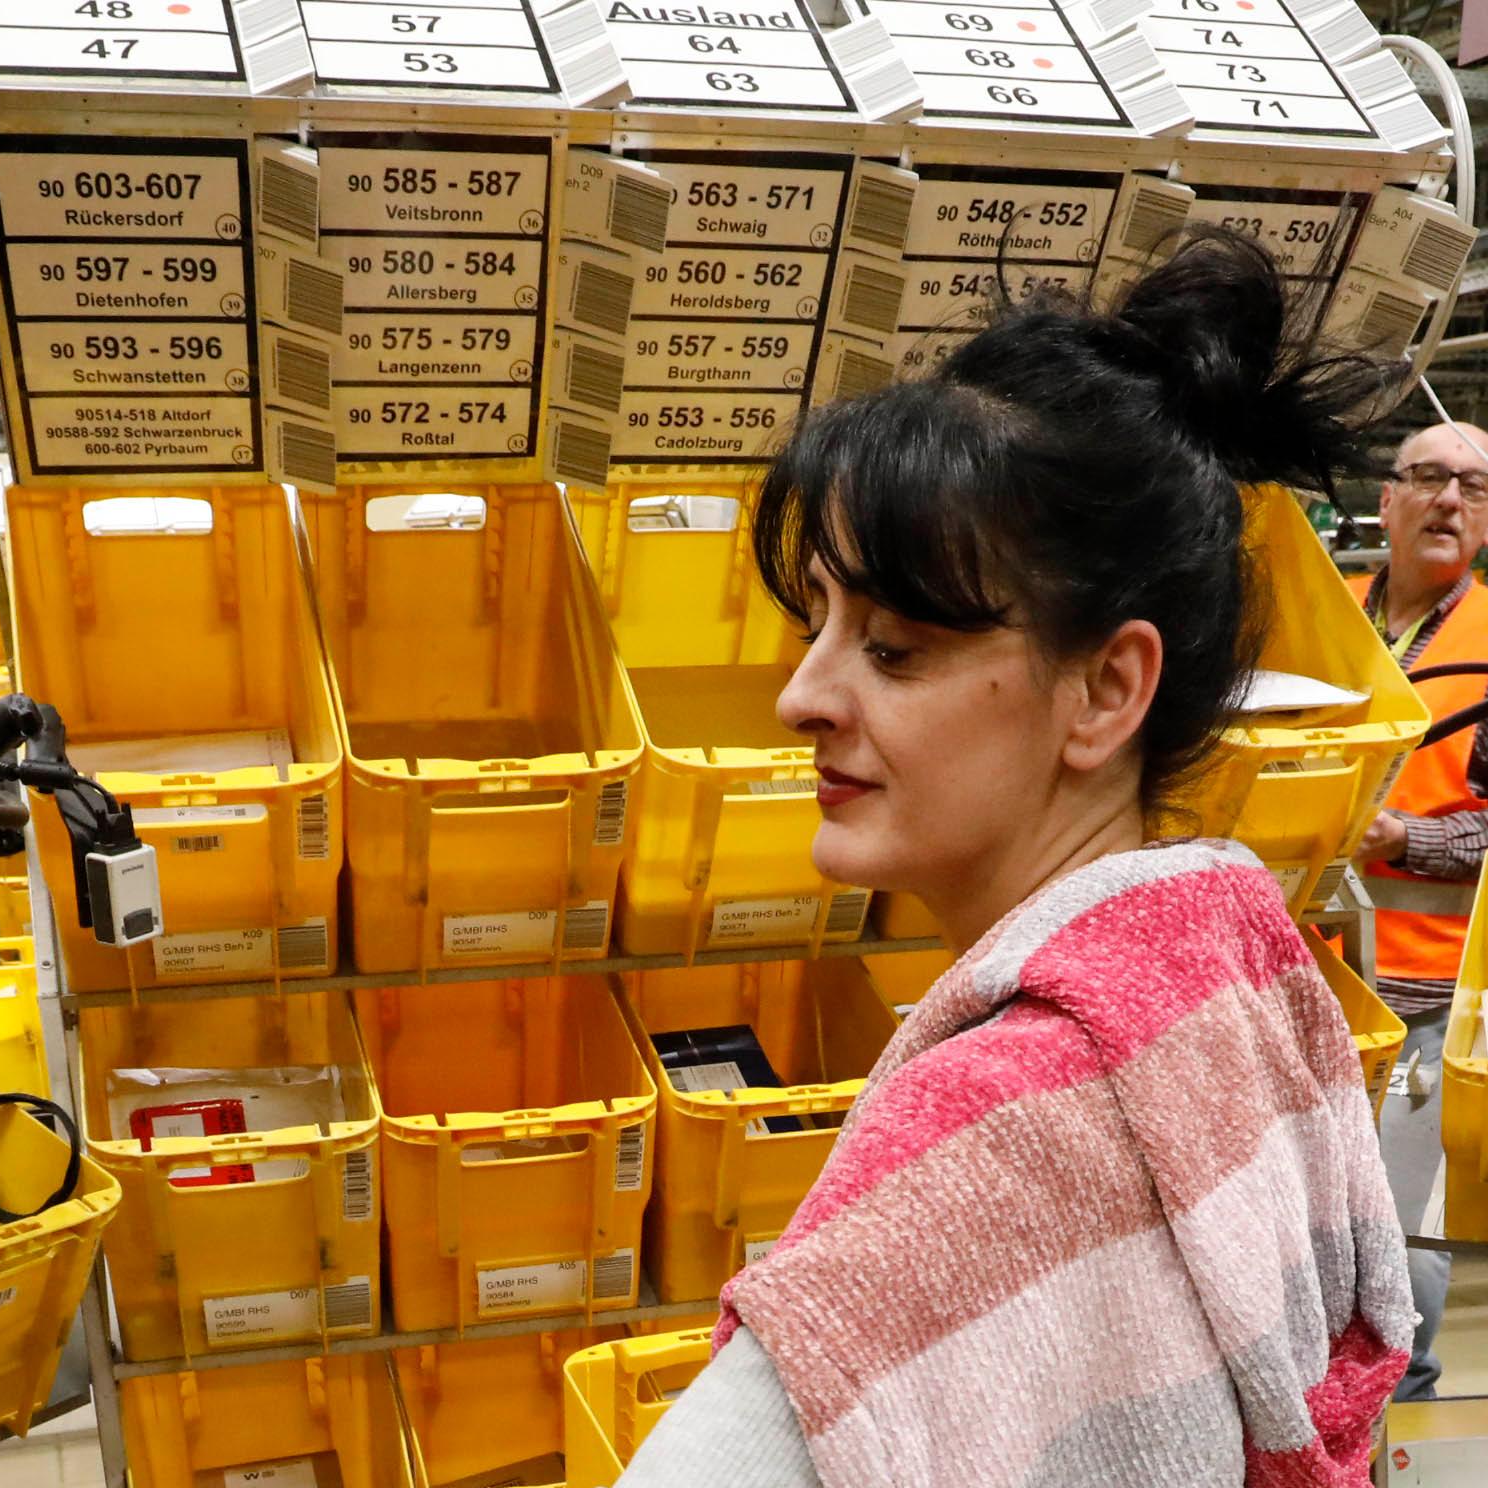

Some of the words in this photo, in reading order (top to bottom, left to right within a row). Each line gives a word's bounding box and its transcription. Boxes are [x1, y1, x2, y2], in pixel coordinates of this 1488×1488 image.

[392, 15, 441, 33] 57
[608, 3, 795, 29] Ausland
[945, 14, 993, 32] 69
[688, 35, 741, 54] 64
[1194, 29, 1242, 47] 74
[82, 39, 138, 59] 47
[965, 49, 1015, 68] 68
[404, 53, 458, 73] 53
[706, 72, 759, 92] 63
[1216, 64, 1266, 82] 73
[987, 86, 1038, 105] 66
[1241, 99, 1288, 118] 71
[39, 180, 64, 198] 90
[75, 172, 201, 200] 603-607
[348, 175, 372, 192] 90
[384, 168, 436, 194] 585
[468, 171, 521, 196] 587
[688, 182, 737, 207] 563
[766, 185, 814, 210] 571
[65, 209, 183, 226] Rückersdorf
[386, 204, 482, 222] Veitsbronn
[937, 205, 958, 221] 90
[967, 199, 1013, 224] 548
[1040, 202, 1087, 226] 552
[697, 217, 767, 238] Schwaig
[958, 233, 1051, 249] Röthenbach
[40, 264, 64, 281] 90
[76, 257, 129, 281] 597
[164, 258, 216, 282] 599
[349, 257, 371, 273] 90
[383, 250, 434, 274] 580
[465, 252, 515, 276] 584
[76, 292, 188, 307] Dietenhofen
[387, 285, 477, 304] Allersberg
[50, 343, 74, 359] 90
[85, 336, 138, 359] 593
[170, 336, 222, 359] 596
[73, 369, 206, 383] Schwanstetten
[75, 408, 156, 421] 90514-518
[162, 410, 211, 421] Altdorf
[349, 409, 371, 423] 90
[381, 402, 429, 423] 572
[458, 402, 506, 423] 574
[629, 413, 649, 427] 90
[658, 407, 703, 428] 553
[730, 408, 775, 429] 556
[46, 427, 119, 438] 90588-592
[124, 427, 242, 438] Schwarzenbruck
[402, 432, 454, 445] Roßtal
[85, 443, 141, 454] 600-602
[144, 443, 208, 456] Pyrbaum
[655, 436, 743, 452] Cadolzburg
